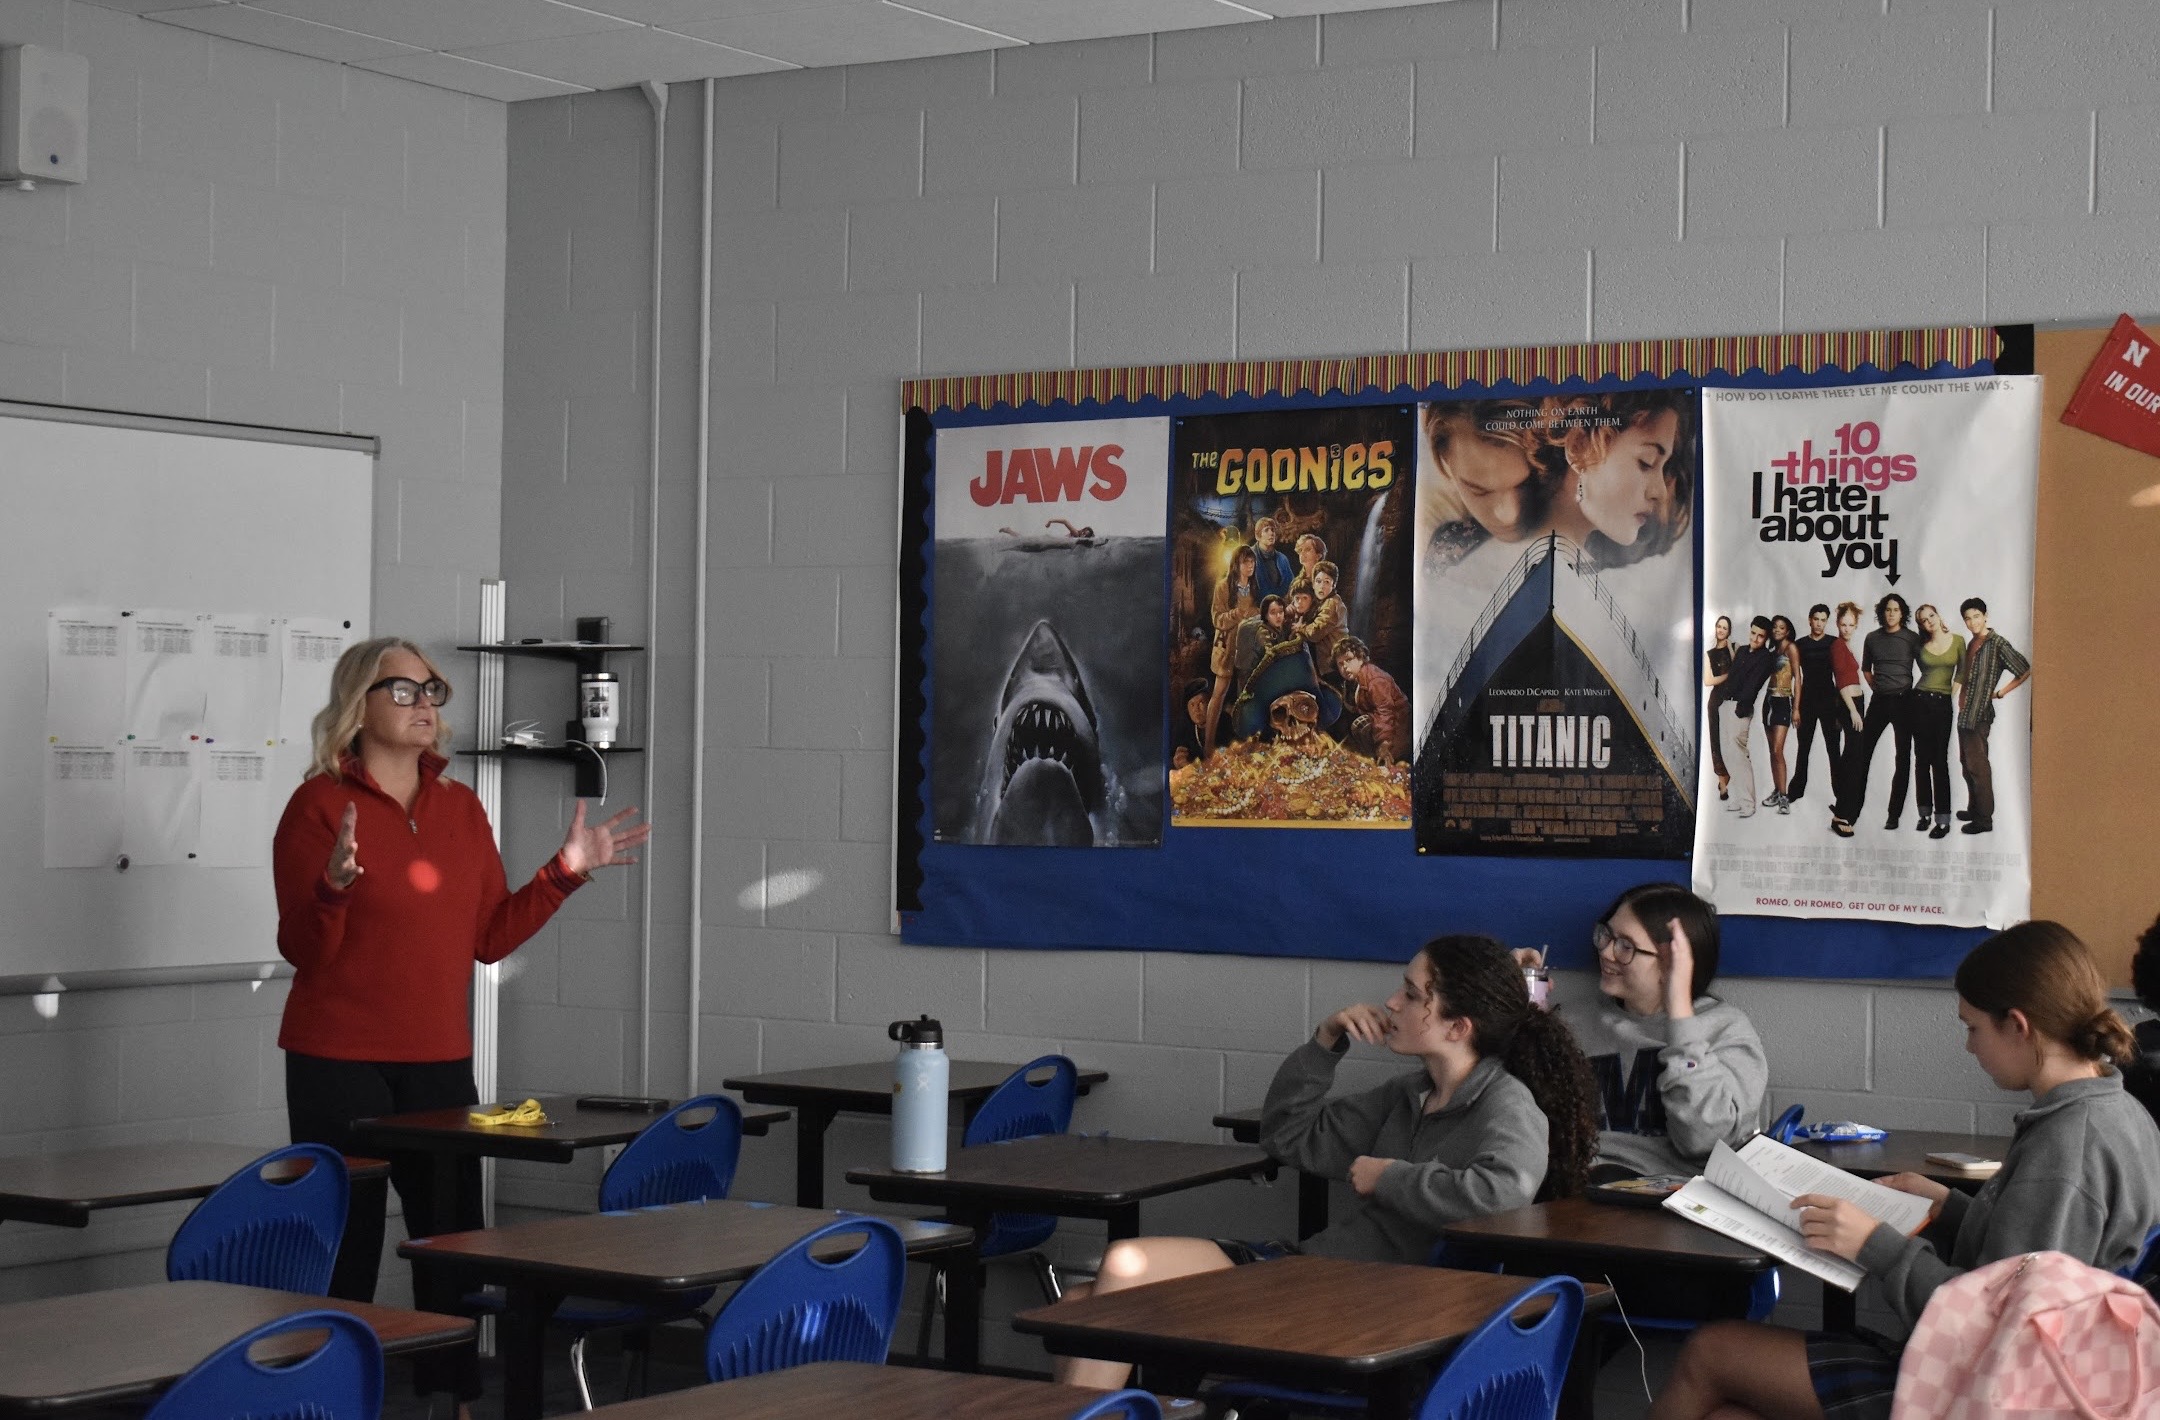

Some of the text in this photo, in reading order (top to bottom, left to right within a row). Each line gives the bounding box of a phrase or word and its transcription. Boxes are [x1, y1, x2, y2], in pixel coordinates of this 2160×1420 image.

[2122, 339, 2150, 368] N
[1506, 406, 1598, 418] NOTHING ON EARTH
[1716, 380, 2014, 401] HOW DO I LOATHE THEE? LET ME COUNT THE WAYS.
[2103, 370, 2160, 414] IN OUR
[1486, 418, 1622, 431] COULD COME BETWEEN THEM.
[1835, 421, 1881, 455] 10
[969, 443, 1127, 507] JAWS
[1771, 440, 1917, 491] things
[1752, 472, 1867, 518] I hate
[1759, 496, 1889, 542] about
[1821, 539, 1899, 583] you
[1489, 715, 1611, 769] TITANIC
[1756, 898, 1790, 907] ROMEO,
[1794, 899, 1807, 907] OH
[1810, 900, 1845, 909] ROMEO,
[1848, 902, 1865, 910] GET
[1867, 903, 1885, 911] OUT
[1888, 904, 1900, 912] OF
[1920, 906, 1944, 914] FACE.
